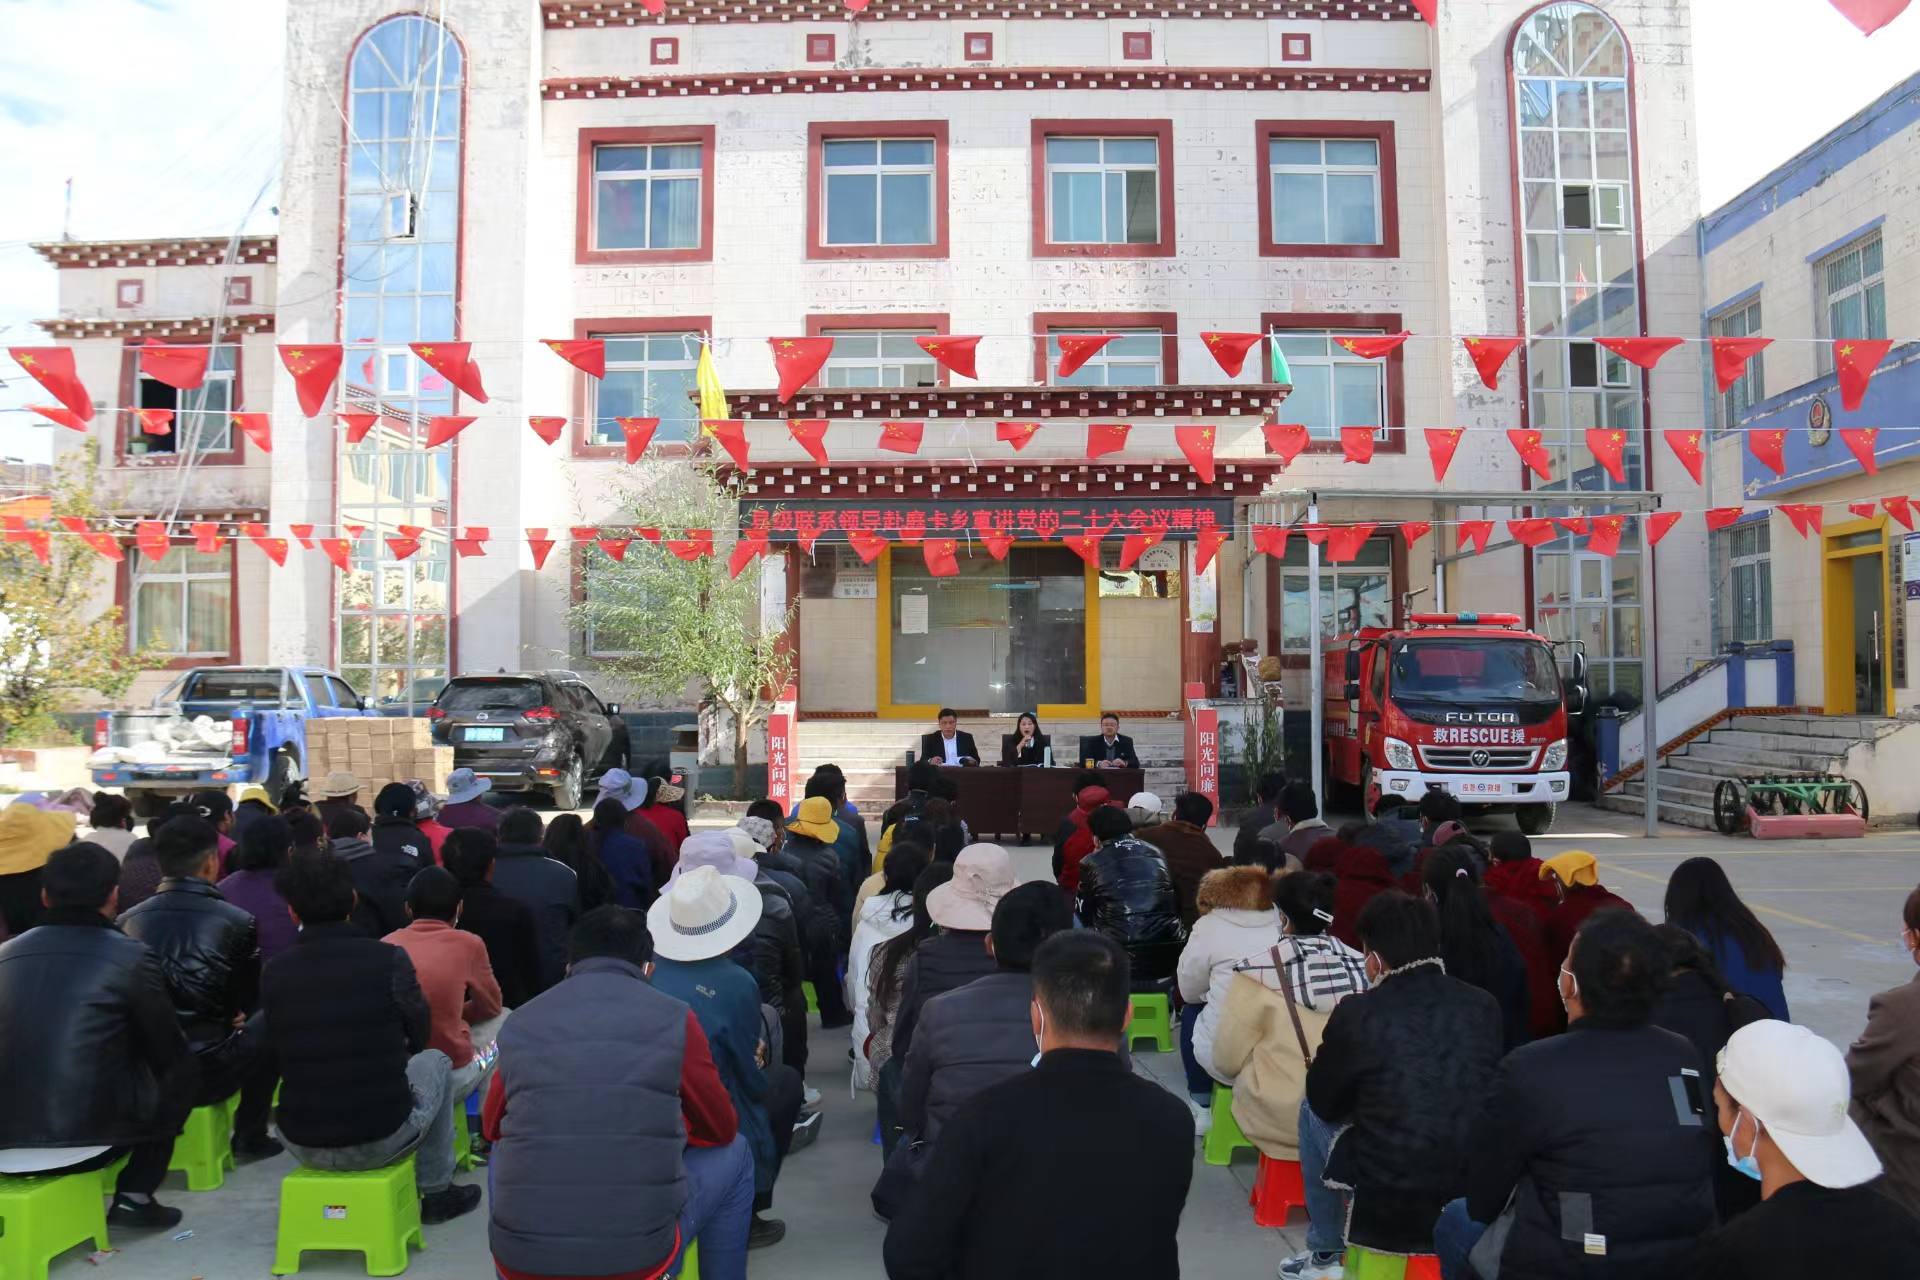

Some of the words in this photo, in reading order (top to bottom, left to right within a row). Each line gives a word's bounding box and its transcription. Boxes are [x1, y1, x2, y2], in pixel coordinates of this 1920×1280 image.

[1446, 712, 1514, 722] FOTON
[771, 736, 786, 797] 阳光问廉
[1200, 732, 1215, 793] 阳光问廉
